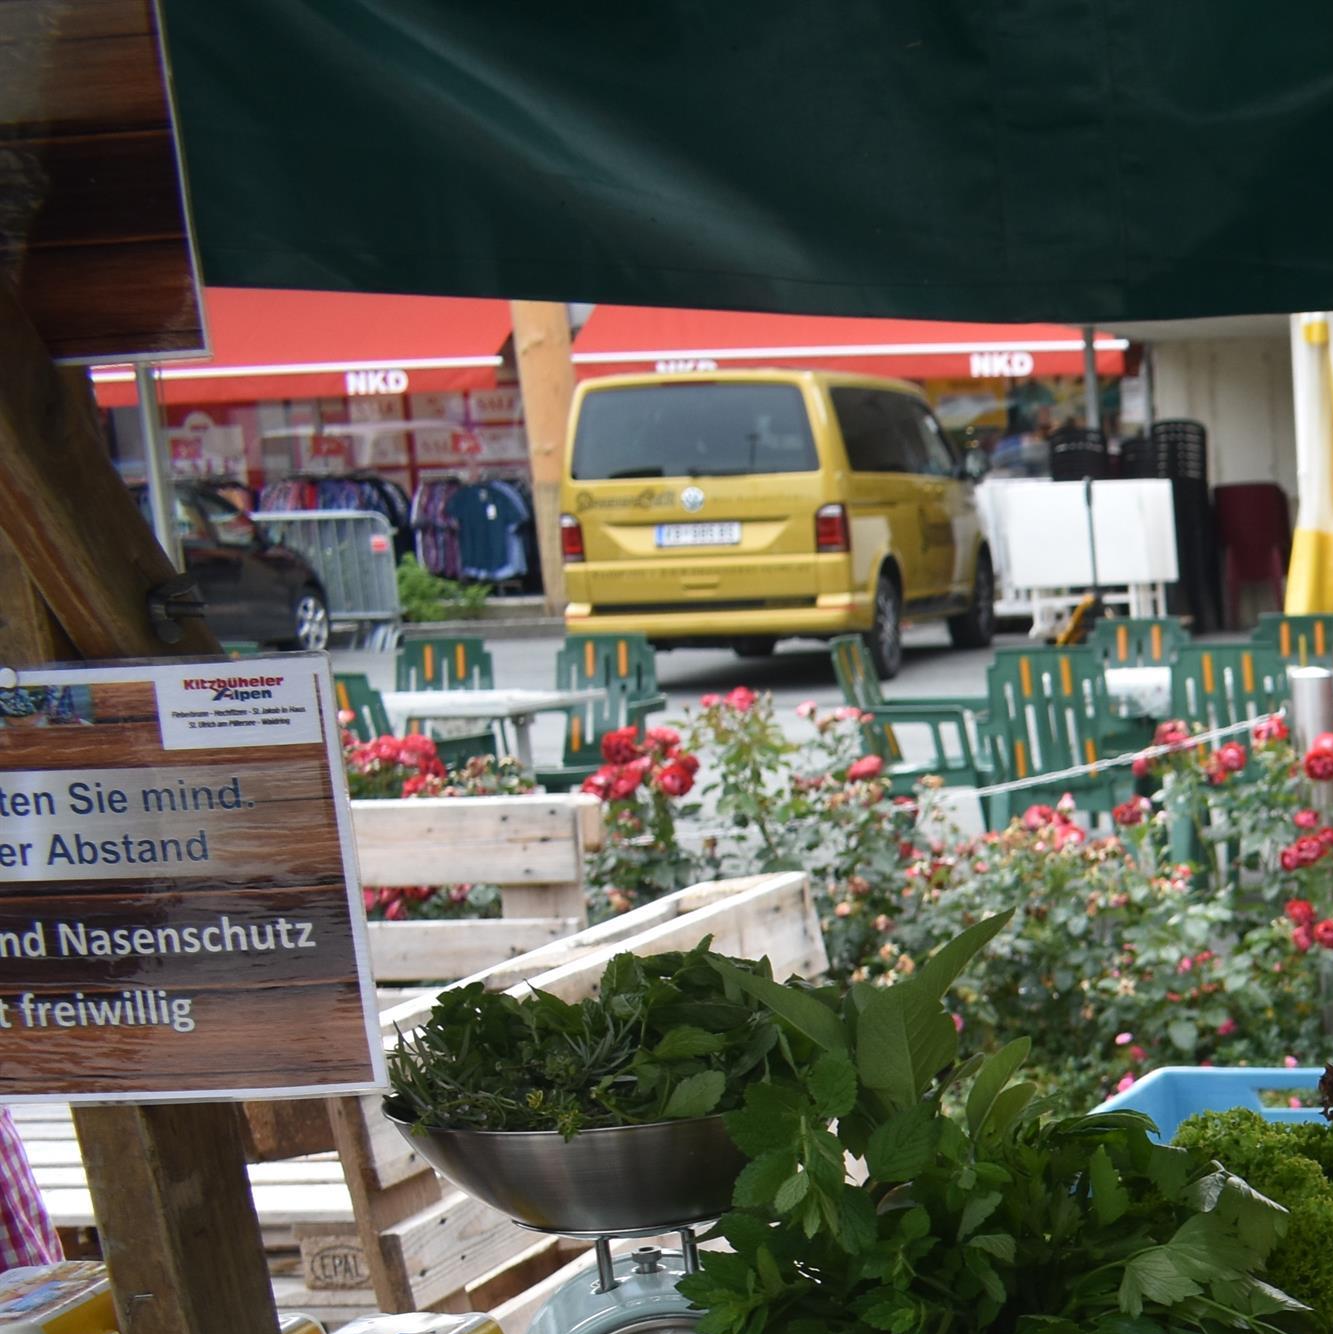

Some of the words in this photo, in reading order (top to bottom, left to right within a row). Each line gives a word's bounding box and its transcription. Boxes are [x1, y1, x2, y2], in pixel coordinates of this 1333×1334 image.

[970, 353, 1033, 377] NKD
[346, 370, 408, 394] NKD
[183, 676, 284, 691] Kitzbüheler
[212, 688, 272, 701] Alpen
[70, 781, 128, 814] Sie
[143, 777, 256, 813] mind.
[0, 842, 33, 866] er
[48, 830, 209, 865] Abstand
[59, 916, 317, 956] Nasenschutz
[20, 990, 196, 1033] freiwillig
[320, 1253, 361, 1281] EPAL
